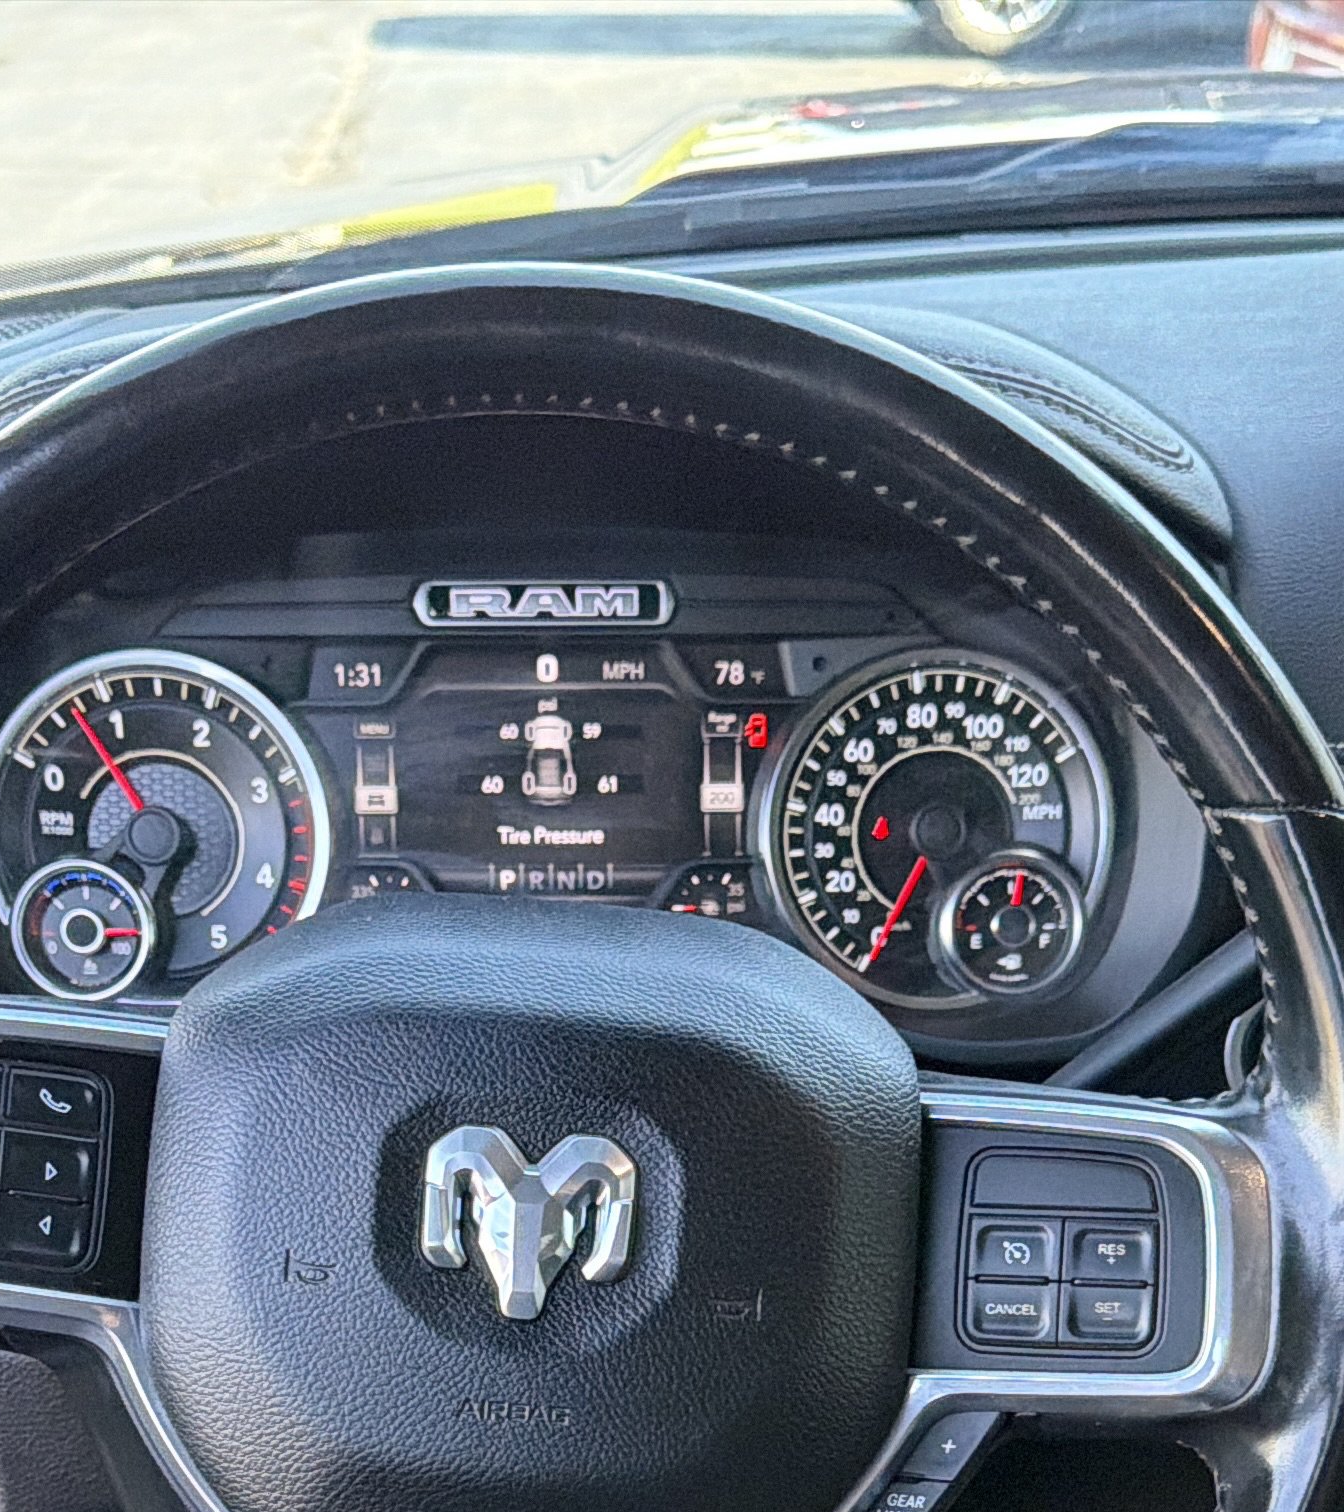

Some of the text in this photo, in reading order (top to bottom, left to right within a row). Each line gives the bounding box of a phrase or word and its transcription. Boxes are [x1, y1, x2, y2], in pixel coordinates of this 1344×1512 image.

[448, 586, 640, 617] RAM
[334, 663, 382, 687] 1:31
[536, 653, 558, 684] 0
[602, 661, 645, 681] MPH
[714, 661, 744, 686] 78
[906, 703, 937, 728] 80
[944, 701, 966, 719] 90
[109, 709, 125, 739] 1
[876, 717, 897, 735] 70
[962, 713, 1004, 739] 100
[193, 720, 211, 748] 2
[1004, 735, 1030, 752] 110
[843, 738, 875, 763] 60
[44, 765, 65, 791] 0
[597, 775, 618, 793] 61
[826, 769, 847, 787] 50
[1007, 762, 1049, 788] 120
[251, 777, 268, 804] 3
[481, 776, 504, 794] 60
[38, 809, 74, 827] RPM
[814, 803, 845, 826] 40
[1023, 803, 1063, 820] MPH
[497, 827, 605, 845] Tire Pressure
[814, 842, 835, 859] 30
[256, 863, 274, 889] 4
[500, 870, 605, 889] P R N D
[825, 870, 856, 893] 20
[842, 908, 861, 924] 10
[210, 925, 228, 950] 5
[971, 934, 983, 949] E
[1039, 934, 1050, 949] F
[1098, 1244, 1126, 1256] RES
[985, 1304, 1037, 1316] CANCEL
[1094, 1302, 1121, 1314] SET
[456, 1397, 571, 1427] AIRBAG
[887, 1493, 926, 1509] GEAR
